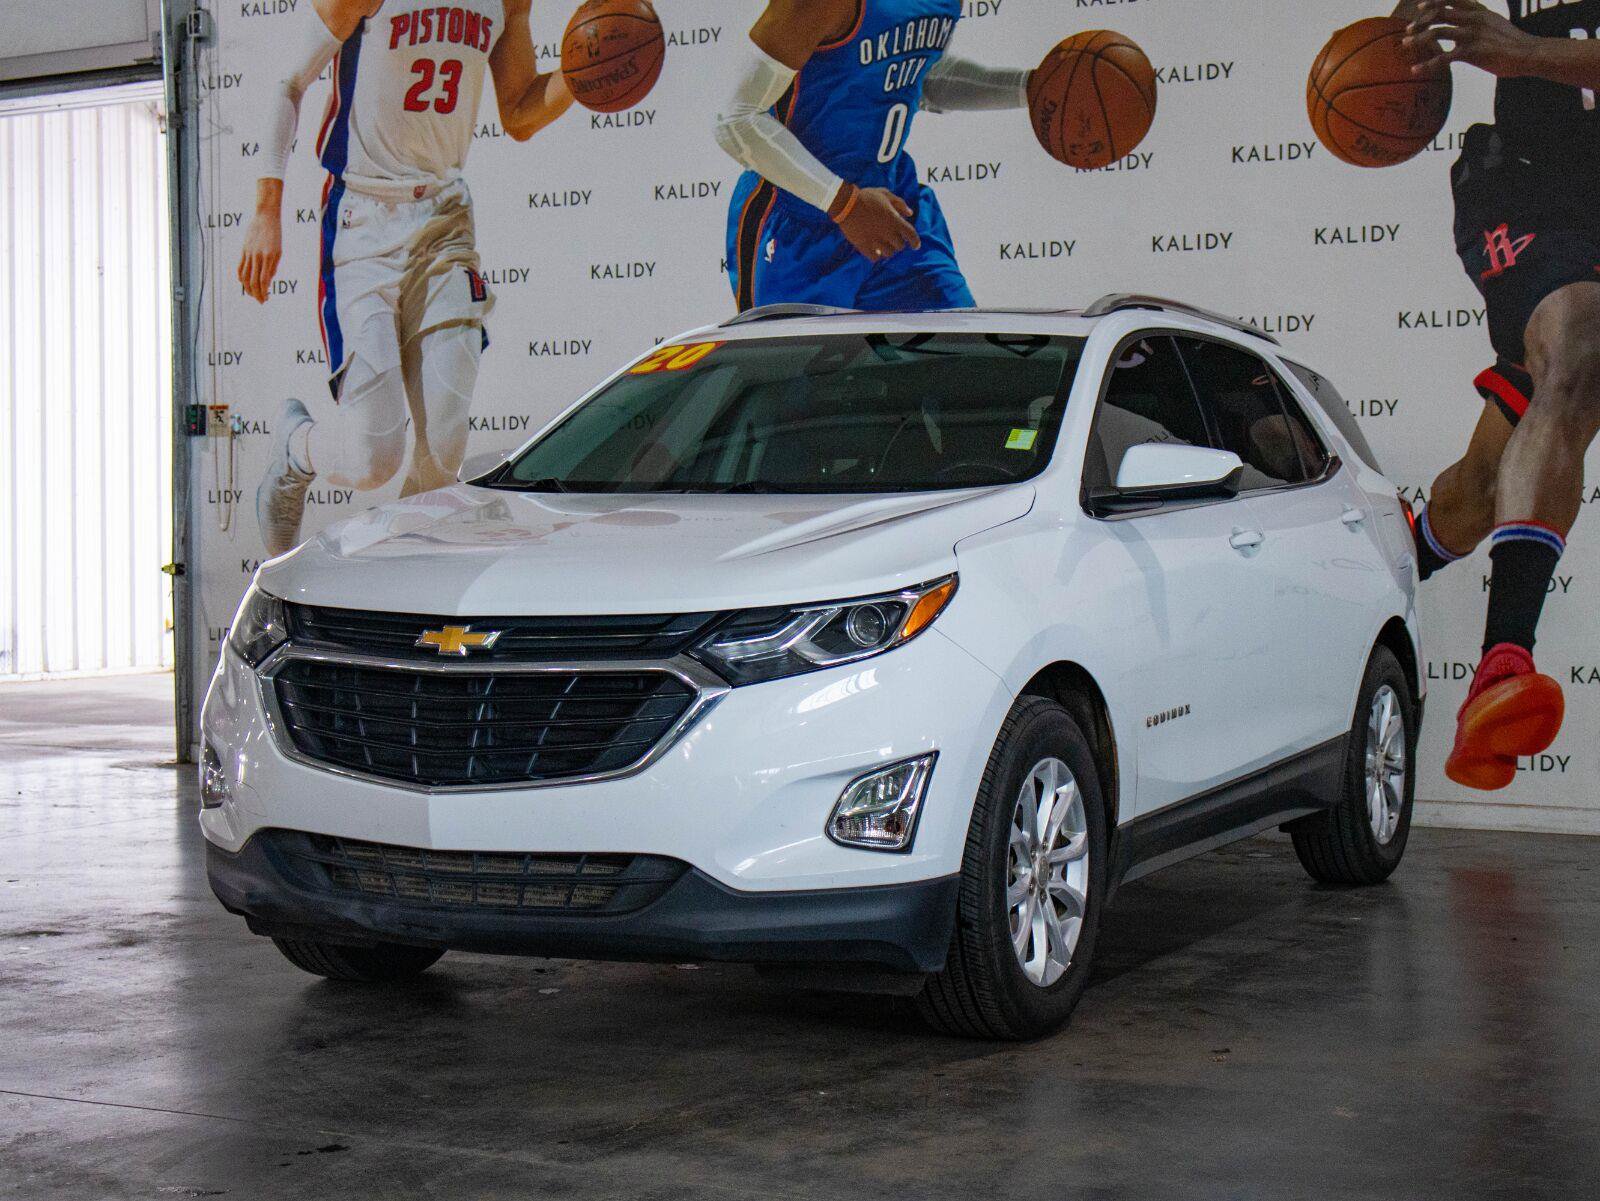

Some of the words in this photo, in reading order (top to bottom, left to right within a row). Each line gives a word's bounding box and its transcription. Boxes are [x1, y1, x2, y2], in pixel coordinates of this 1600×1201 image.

[241, 0, 298, 17] KALIDY
[389, 7, 493, 53] PISTONS
[667, 27, 722, 46] ALIDY
[883, 57, 927, 92] CITY
[403, 58, 463, 114] 23
[590, 110, 656, 129] KALIDY
[877, 103, 908, 164] 0
[1232, 142, 1317, 163] KALIDY
[927, 163, 1001, 183] KALIDY
[528, 190, 592, 208] KALIDY
[654, 182, 721, 200] KALIDY
[208, 213, 242, 228] LIDY
[1151, 232, 1233, 252] KALIDY
[1315, 224, 1400, 245] KALIDY
[999, 240, 1076, 260] KALIDY
[590, 262, 656, 280] KALIDY
[1398, 309, 1487, 329] KALIDY
[528, 340, 592, 356] KALIDY
[208, 352, 243, 366] LIDY
[242, 421, 270, 434] KAL
[469, 415, 530, 431] KALIDY
[208, 490, 243, 504] LIDY
[306, 490, 354, 505] ALIDY
